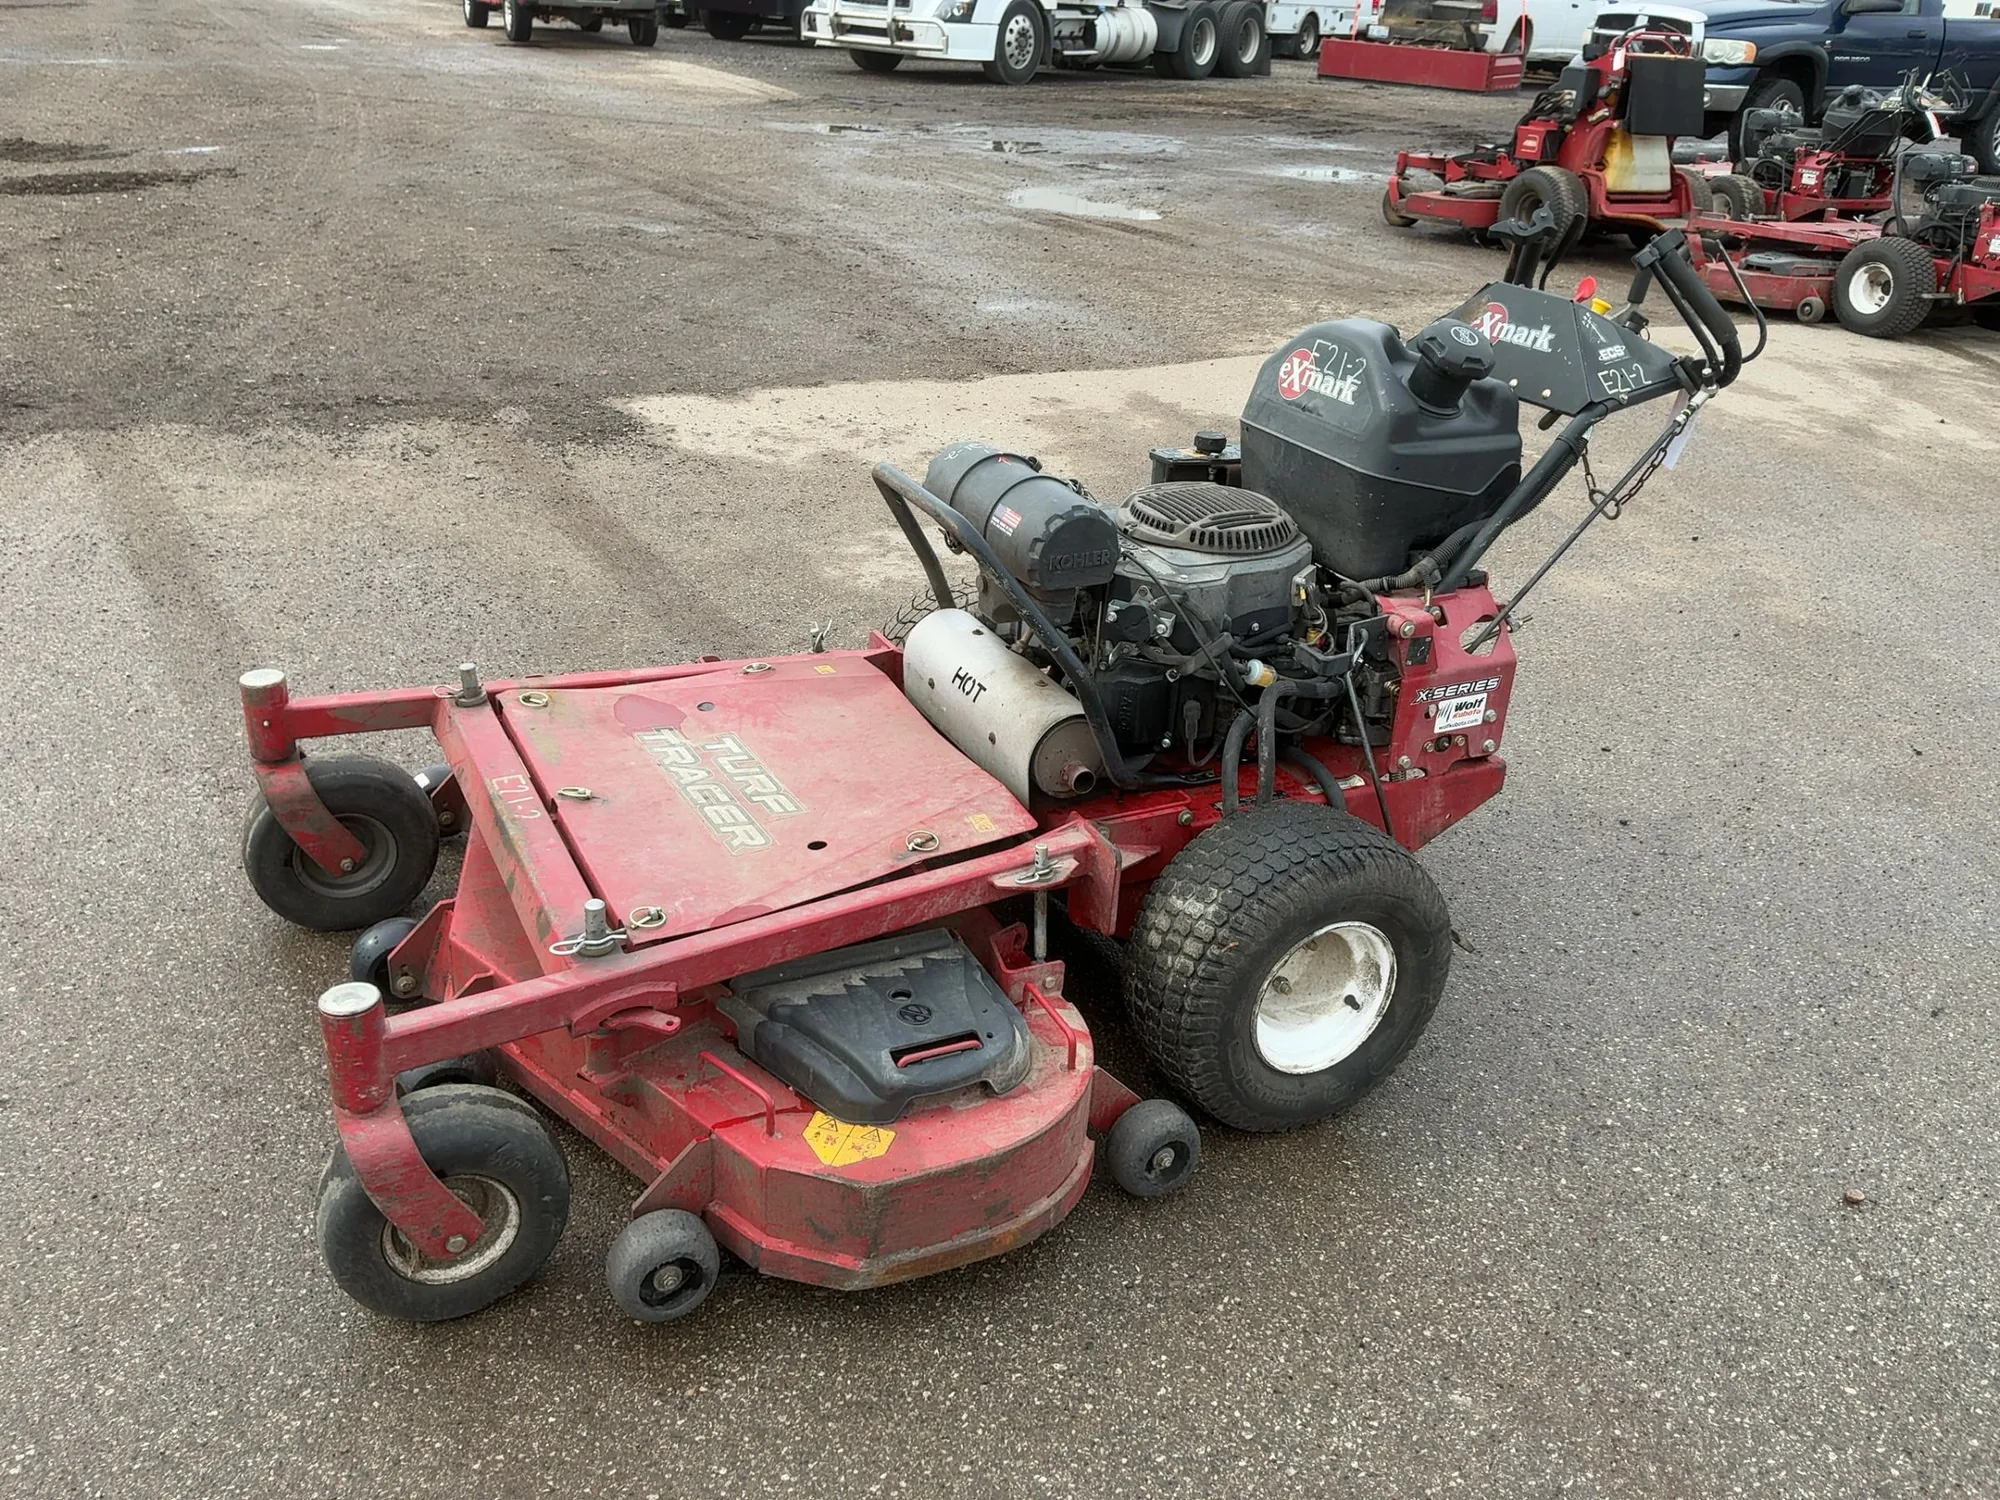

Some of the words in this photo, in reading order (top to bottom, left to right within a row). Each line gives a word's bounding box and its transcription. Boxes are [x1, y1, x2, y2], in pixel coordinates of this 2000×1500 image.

[1307, 339, 1366, 384] E21-2
[1280, 356, 1359, 405] eXmark
[1597, 363, 1653, 394] E21-2
[1049, 549, 1112, 571] KOHLER
[951, 666, 988, 703] HOT
[1416, 677, 1500, 703] X-SERIES
[1452, 709, 1482, 719] Kubota
[1454, 697, 1484, 712] Wolf
[1438, 718, 1479, 730] wolfkubota.com
[638, 727, 770, 850] TRACER
[702, 733, 803, 814] TURF
